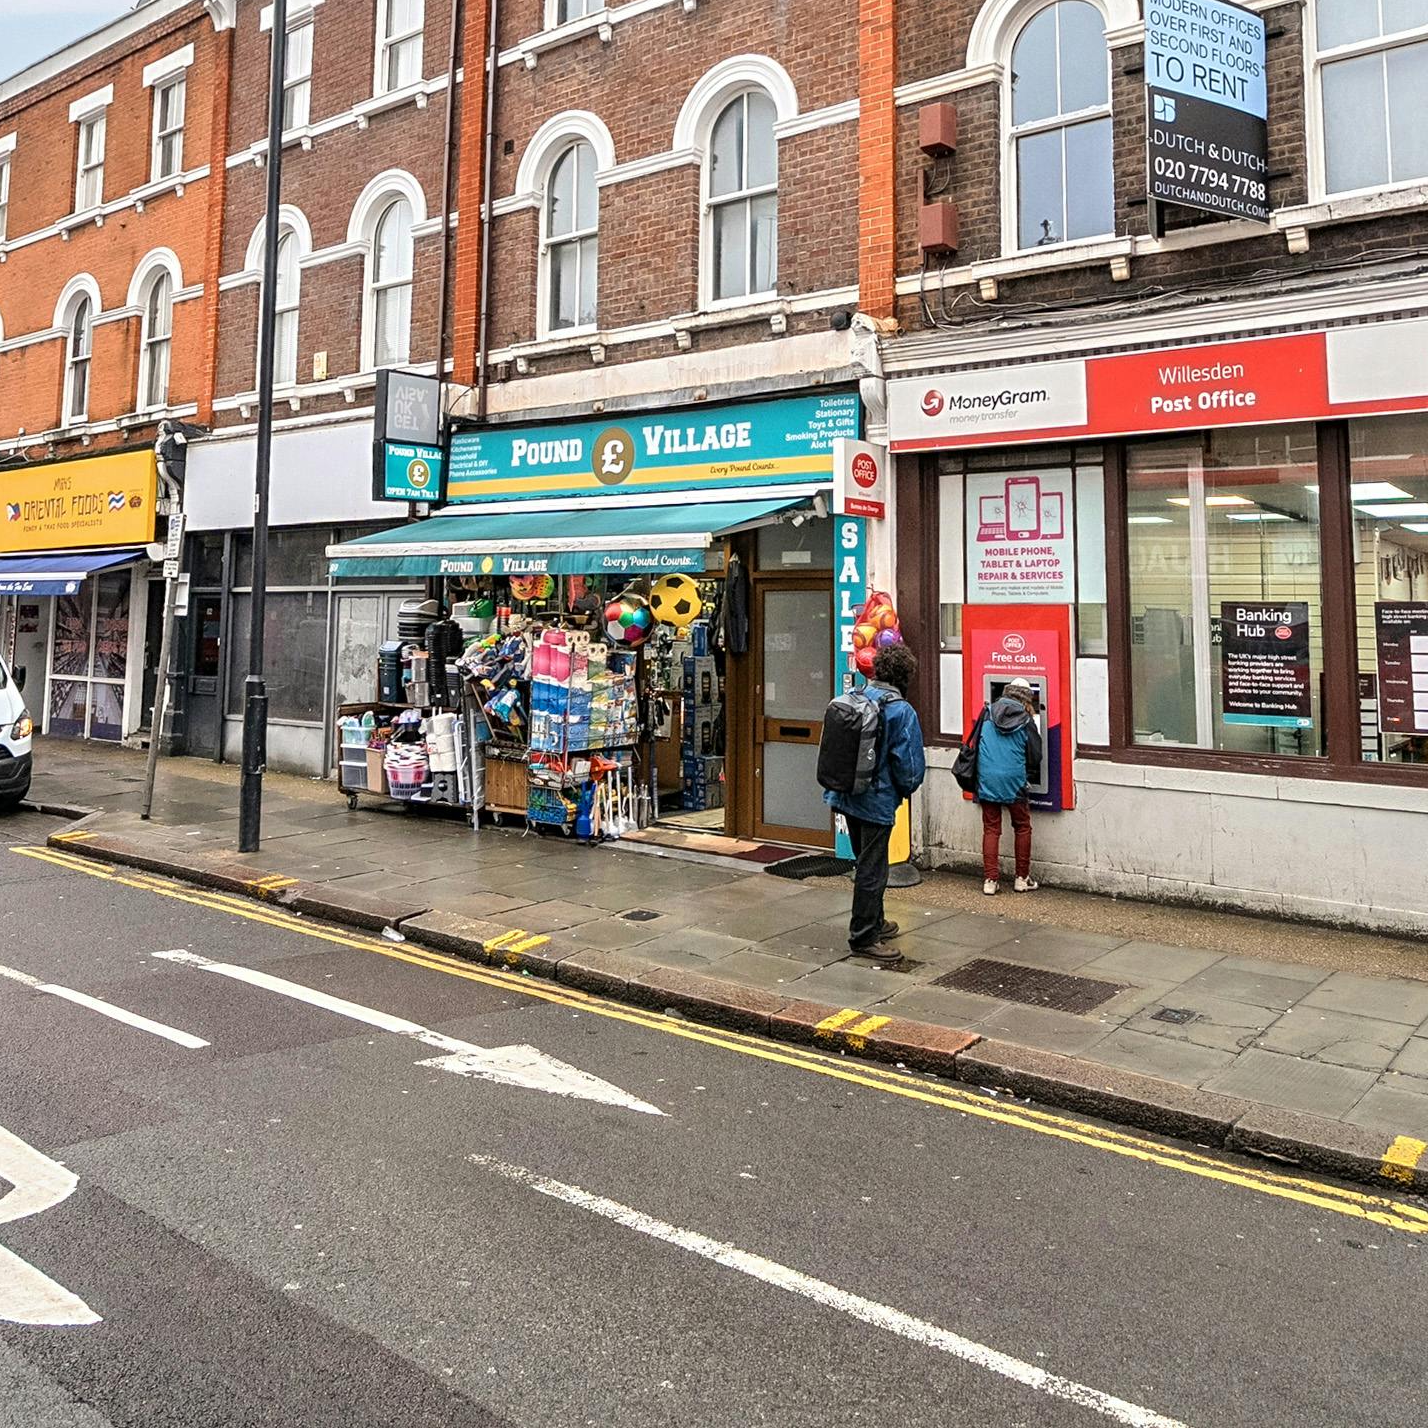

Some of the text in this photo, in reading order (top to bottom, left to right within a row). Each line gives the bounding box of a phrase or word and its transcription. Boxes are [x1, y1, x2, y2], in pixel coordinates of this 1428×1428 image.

[1211, 9, 1261, 40] OFFICES
[1150, 10, 1252, 55] OVER FIRST AND
[1150, 29, 1259, 78] SECOND FLOORS
[1151, 51, 1248, 102] TO RENT
[1153, 129, 1265, 172] DUTCH & DUTCH
[1154, 156, 1266, 202] 020 7794 7788
[1154, 181, 1267, 219] DUTCHANDDUTCH.COM
[1158, 362, 1244, 385] Willesden
[820, 398, 854, 408] Toiletries
[1151, 389, 1256, 414] Post Office
[815, 408, 855, 419] Stationary
[949, 408, 1018, 425] money transfer
[808, 420, 826, 430] Toys
[836, 418, 855, 427] Gifts
[785, 429, 855, 442] Smoking Products
[810, 440, 826, 449] Alot
[478, 459, 489, 467] DIY
[602, 439, 625, 475] £
[710, 466, 728, 476] Every
[729, 463, 752, 472] Pound
[857, 459, 873, 469] POST
[466, 468, 498, 477] Accessories
[854, 469, 875, 481] OFFICE
[24, 492, 104, 521] ORIENTAL FOODS
[984, 546, 1055, 557] MOBILE PHONE,
[602, 556, 627, 571] Every
[629, 554, 659, 567] Pound
[980, 559, 1061, 568] TABLET & LAPTOP
[977, 571, 1064, 581] REPAIR & SERVICES
[839, 522, 860, 652] SALE
[1236, 608, 1292, 624] Banking
[1236, 624, 1266, 638] Hub
[991, 652, 1037, 663] Free cash
[1279, 668, 1295, 676] bring
[1228, 700, 1254, 708] Welcome
[1261, 702, 1284, 710] Banking
